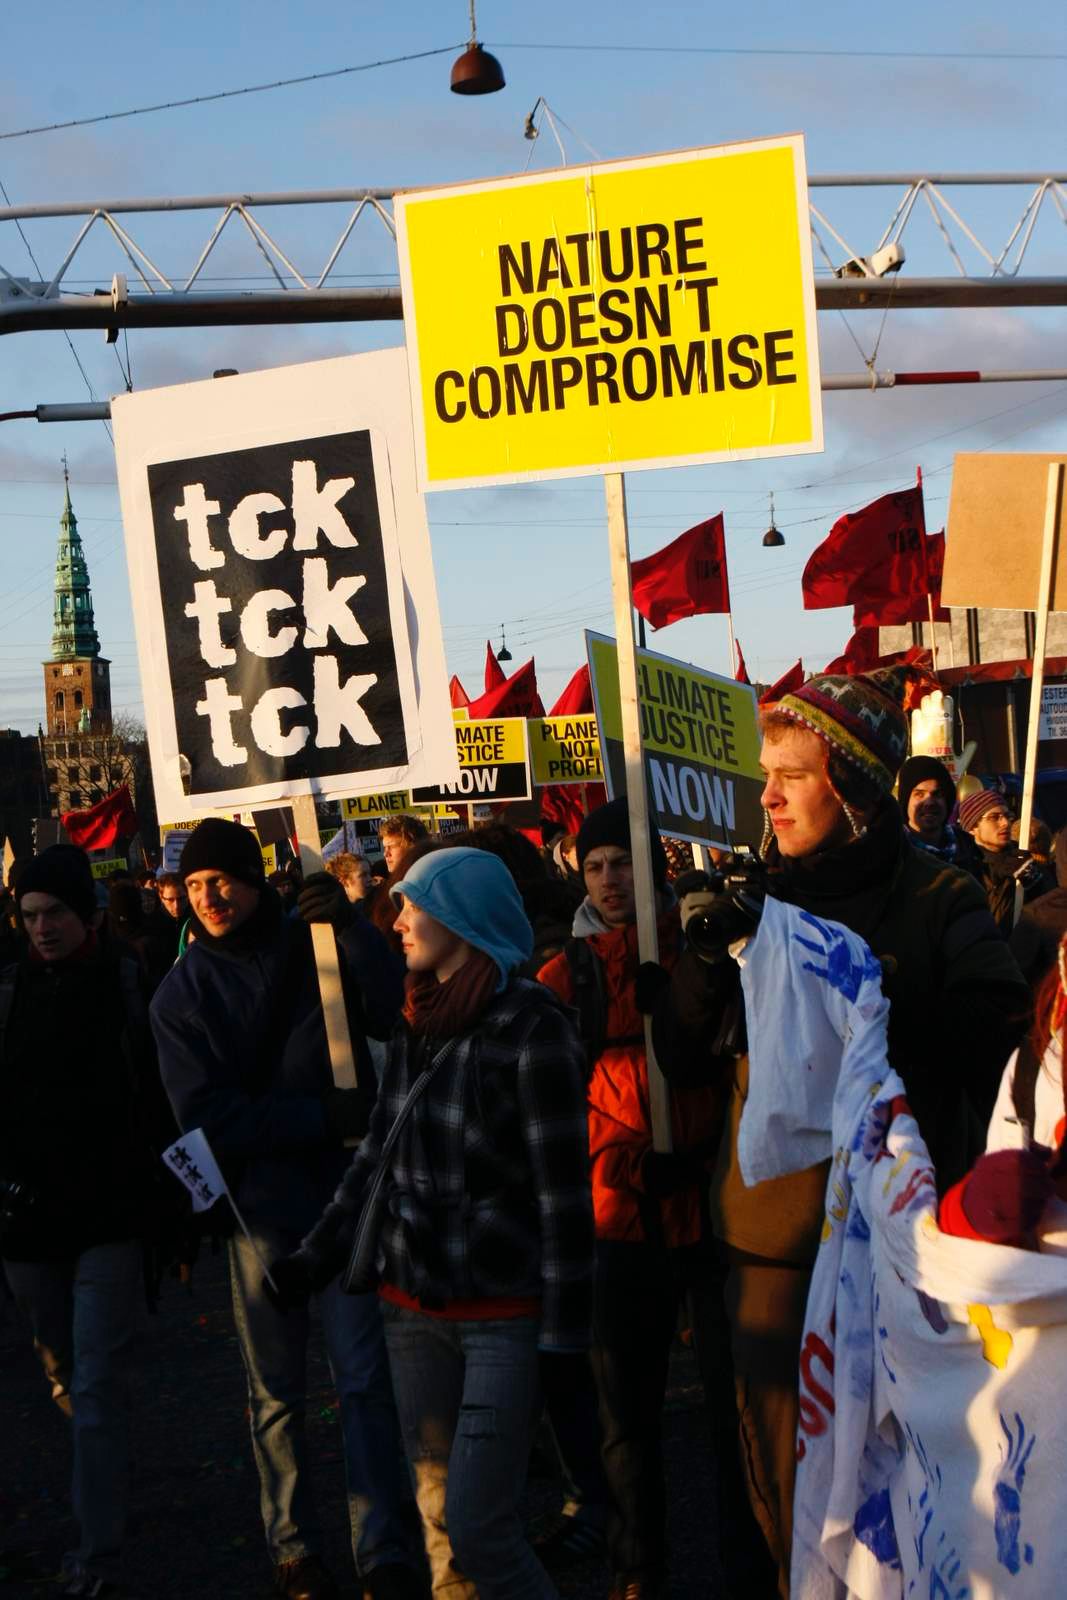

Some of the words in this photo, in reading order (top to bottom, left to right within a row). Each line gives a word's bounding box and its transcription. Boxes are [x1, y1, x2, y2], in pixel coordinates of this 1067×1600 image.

[498, 217, 707, 297] NATURE
[495, 277, 719, 358] DOESN'T
[434, 329, 797, 424] COMPROMISE
[173, 460, 360, 571] tck
[184, 557, 369, 669] tck
[195, 655, 382, 767] tck
[456, 725, 505, 744] MATE
[541, 721, 598, 741] PLANE
[457, 743, 504, 763] STICE
[549, 758, 601, 778] PROFI
[560, 739, 595, 759] NOT
[347, 793, 408, 814] PLANET
[649, 758, 736, 831] NOW
